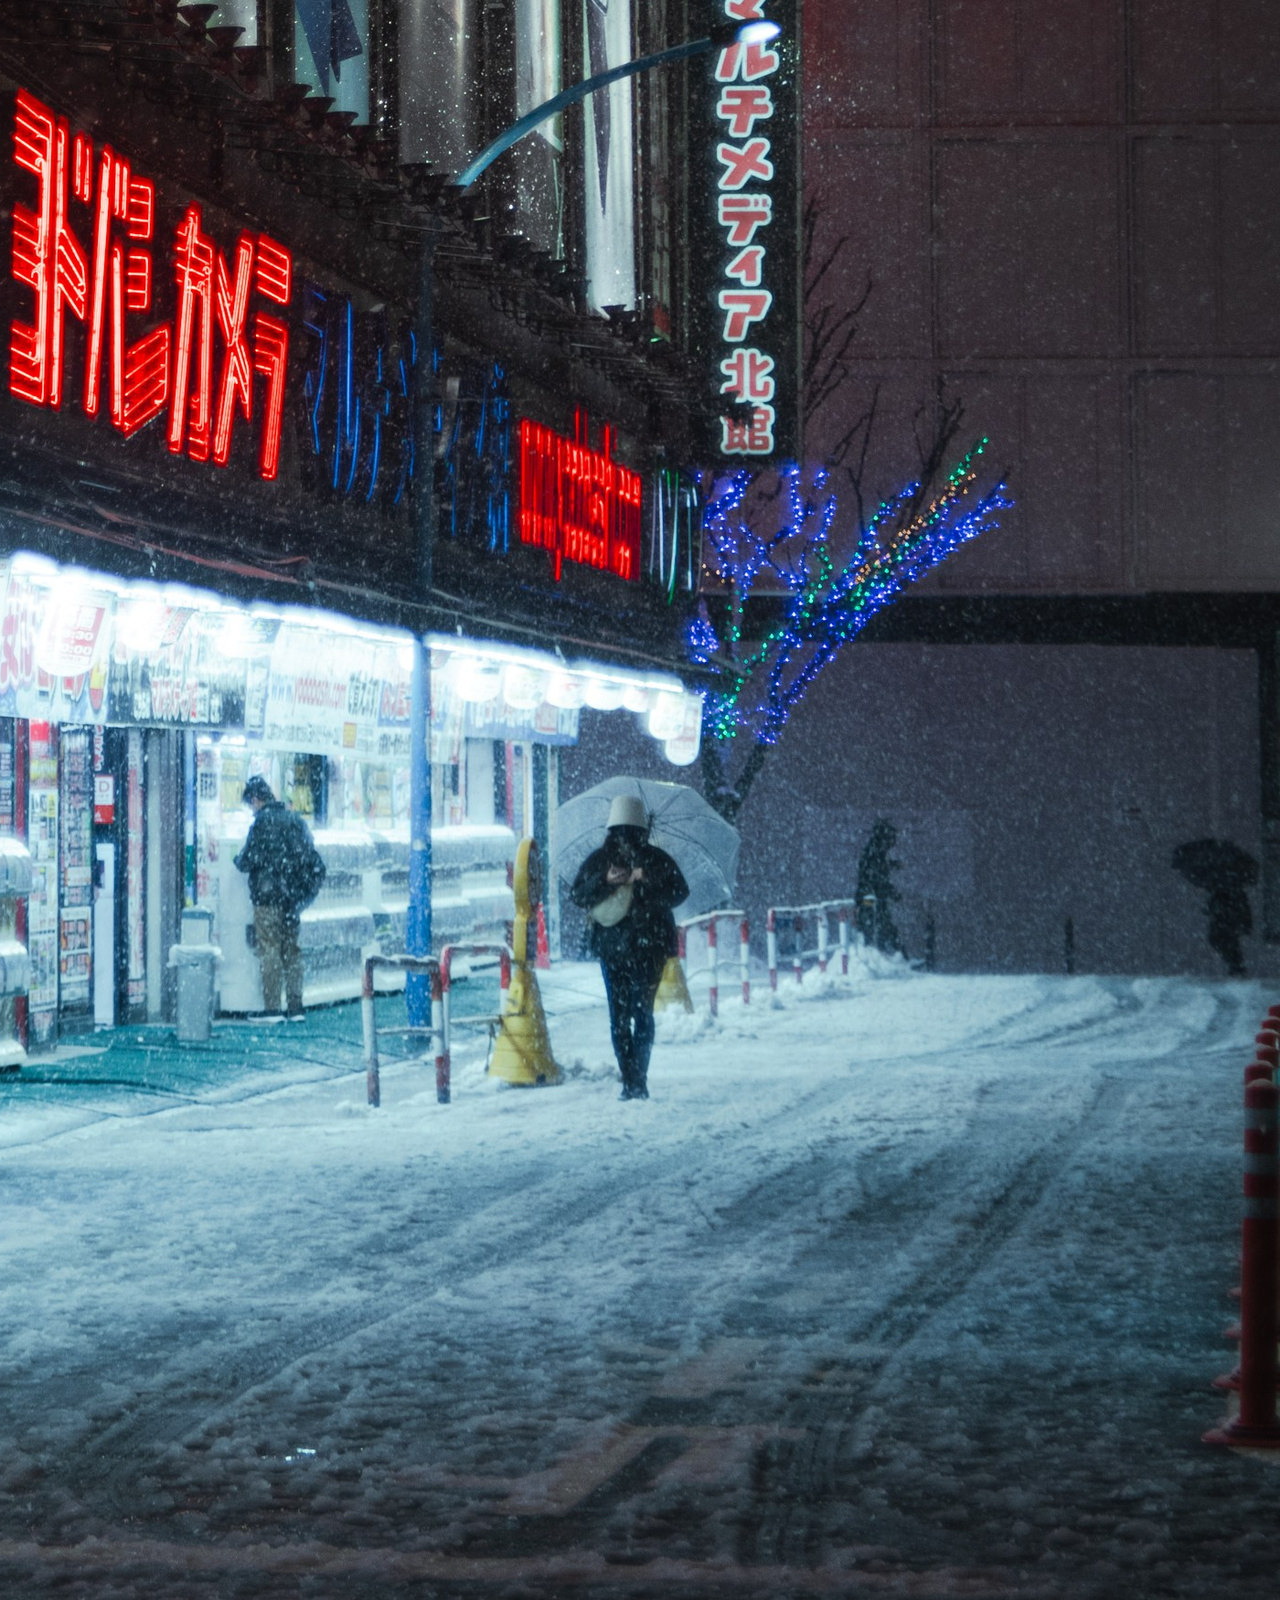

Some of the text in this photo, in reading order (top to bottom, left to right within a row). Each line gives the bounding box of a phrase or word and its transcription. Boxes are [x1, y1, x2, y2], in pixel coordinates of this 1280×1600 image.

[9, 86, 294, 482] ヨドバシカメラ
